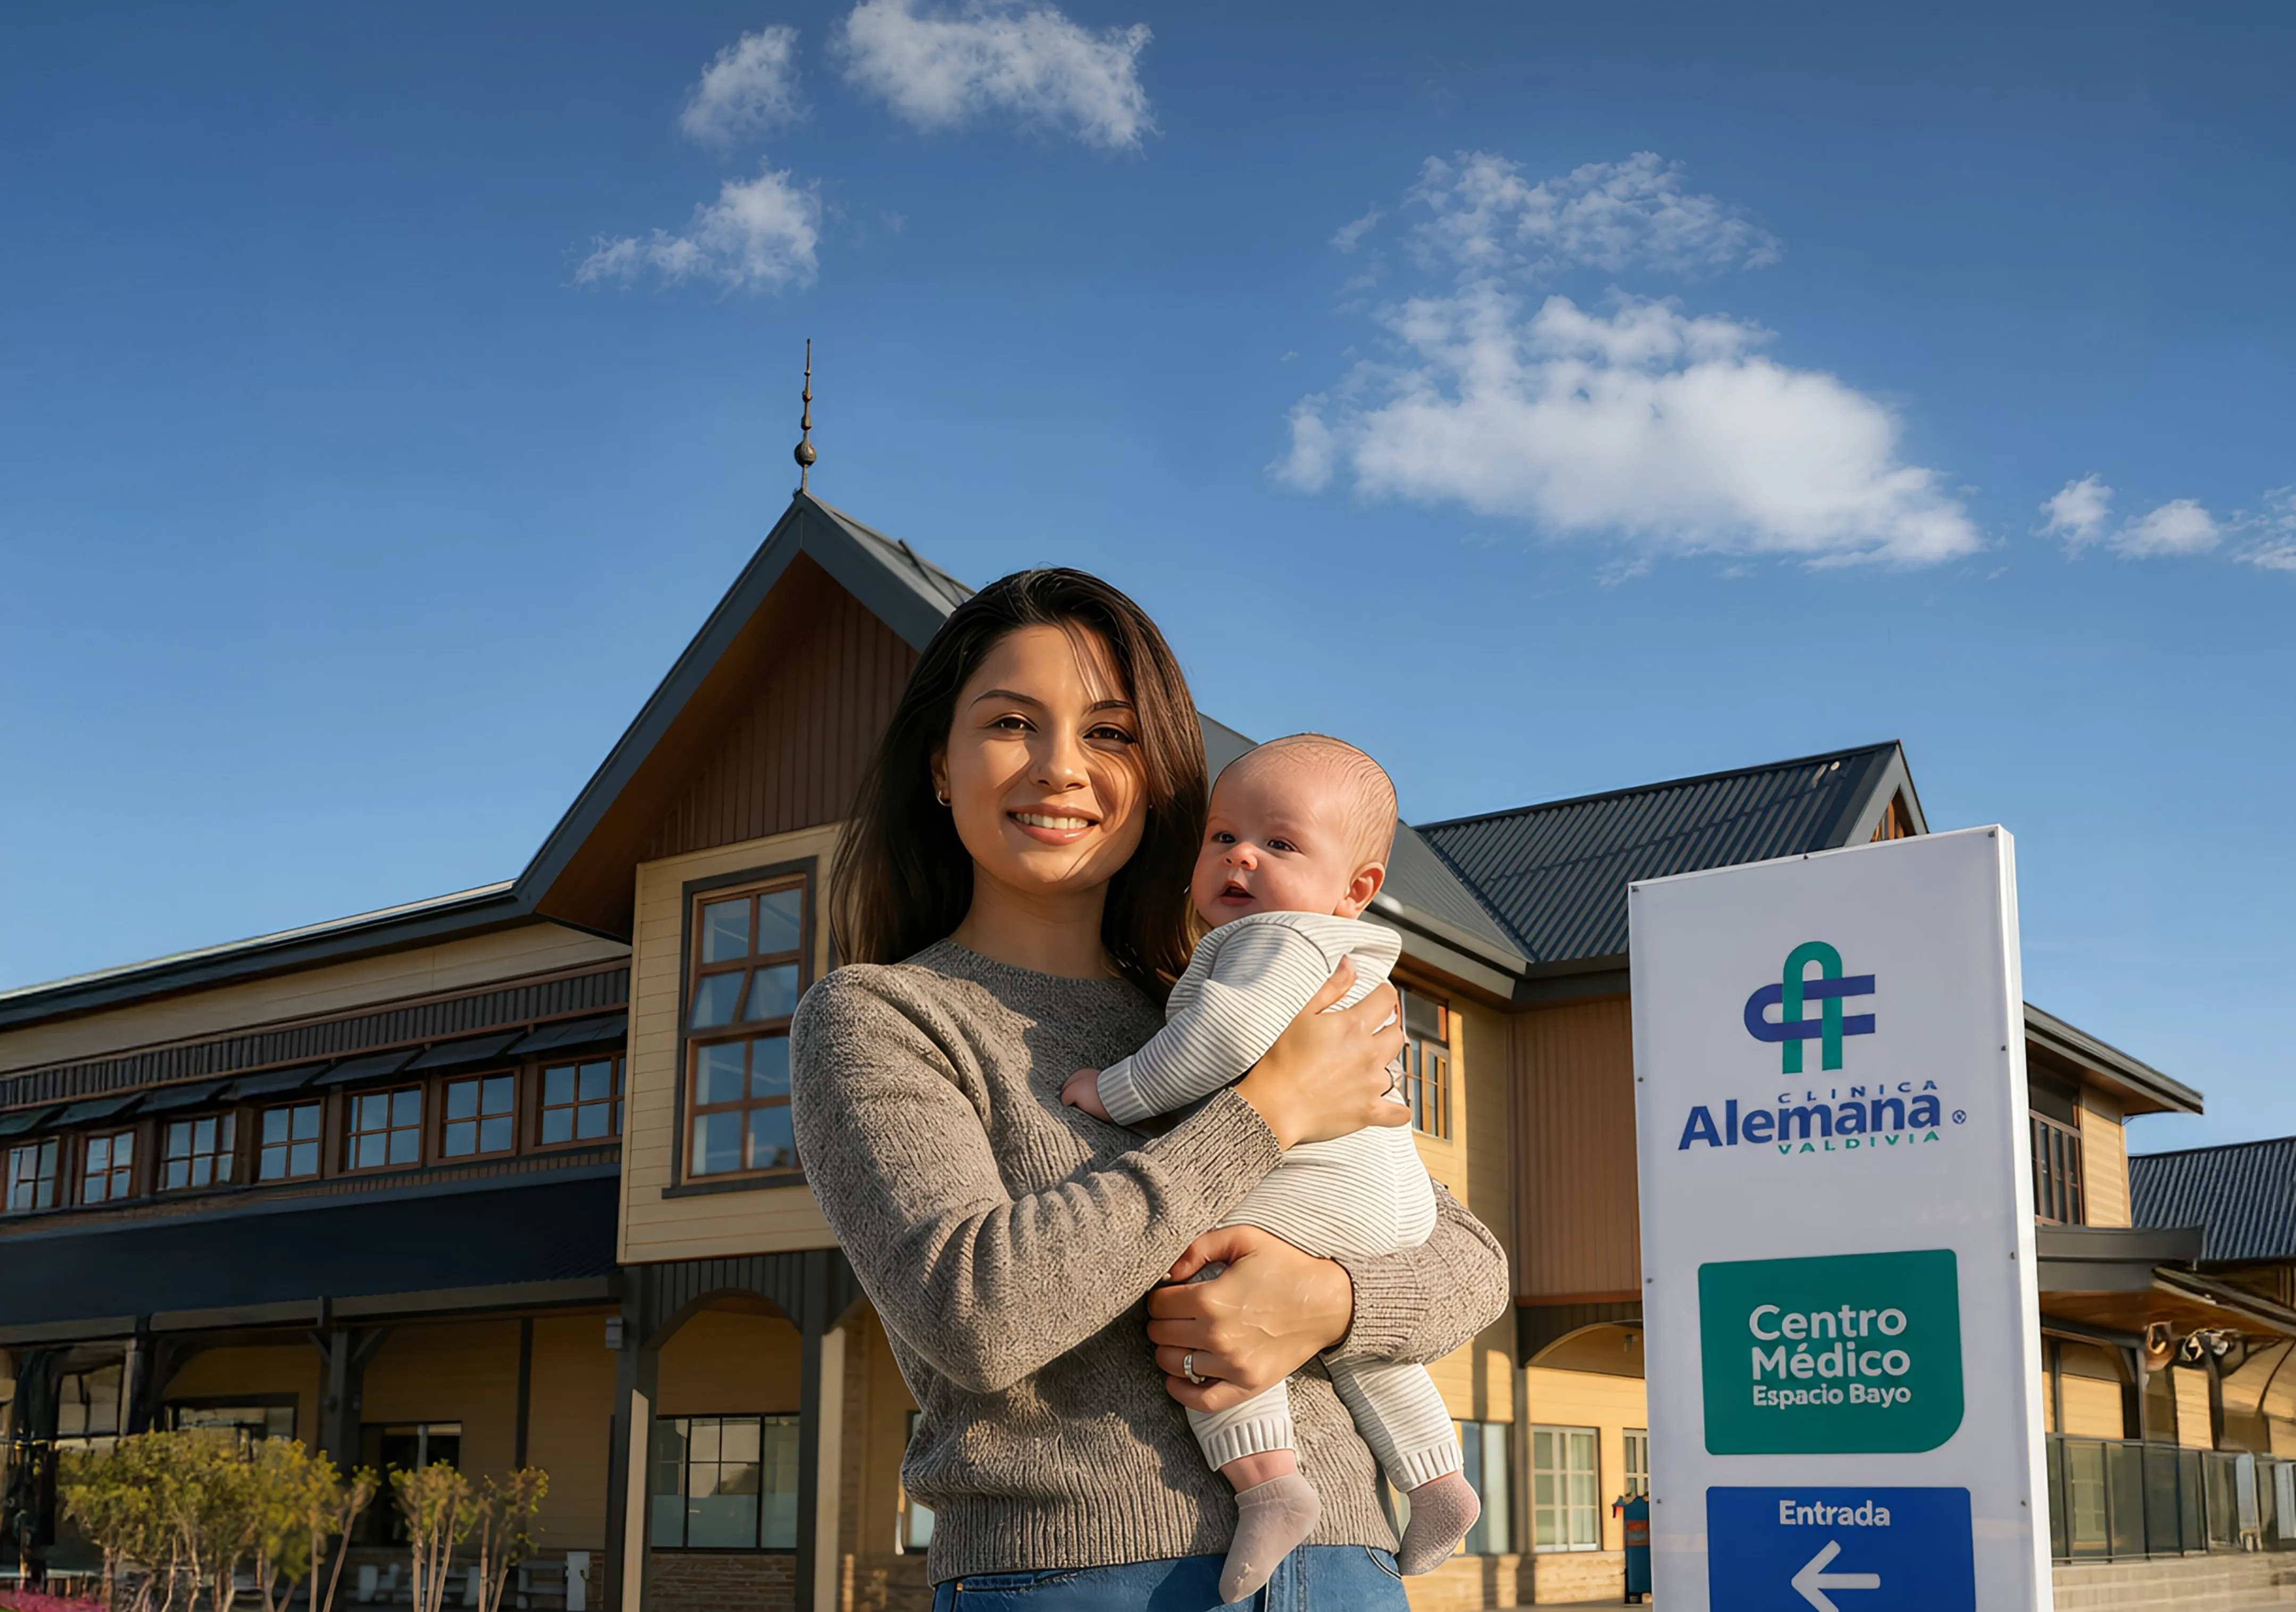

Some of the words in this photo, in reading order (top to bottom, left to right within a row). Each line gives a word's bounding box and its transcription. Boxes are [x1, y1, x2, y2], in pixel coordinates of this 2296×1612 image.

[1777, 1080, 1938, 1104] CLINICA
[1678, 1095, 1941, 1150] Alemana
[1778, 1131, 1940, 1155] VALDIVIA
[1749, 1305, 1907, 1340] Centro
[1751, 1342, 1910, 1380] Médico
[1752, 1383, 1844, 1409] Espacio
[1849, 1384, 1911, 1408] Bayo
[1779, 1500, 1890, 1526] Entrada
